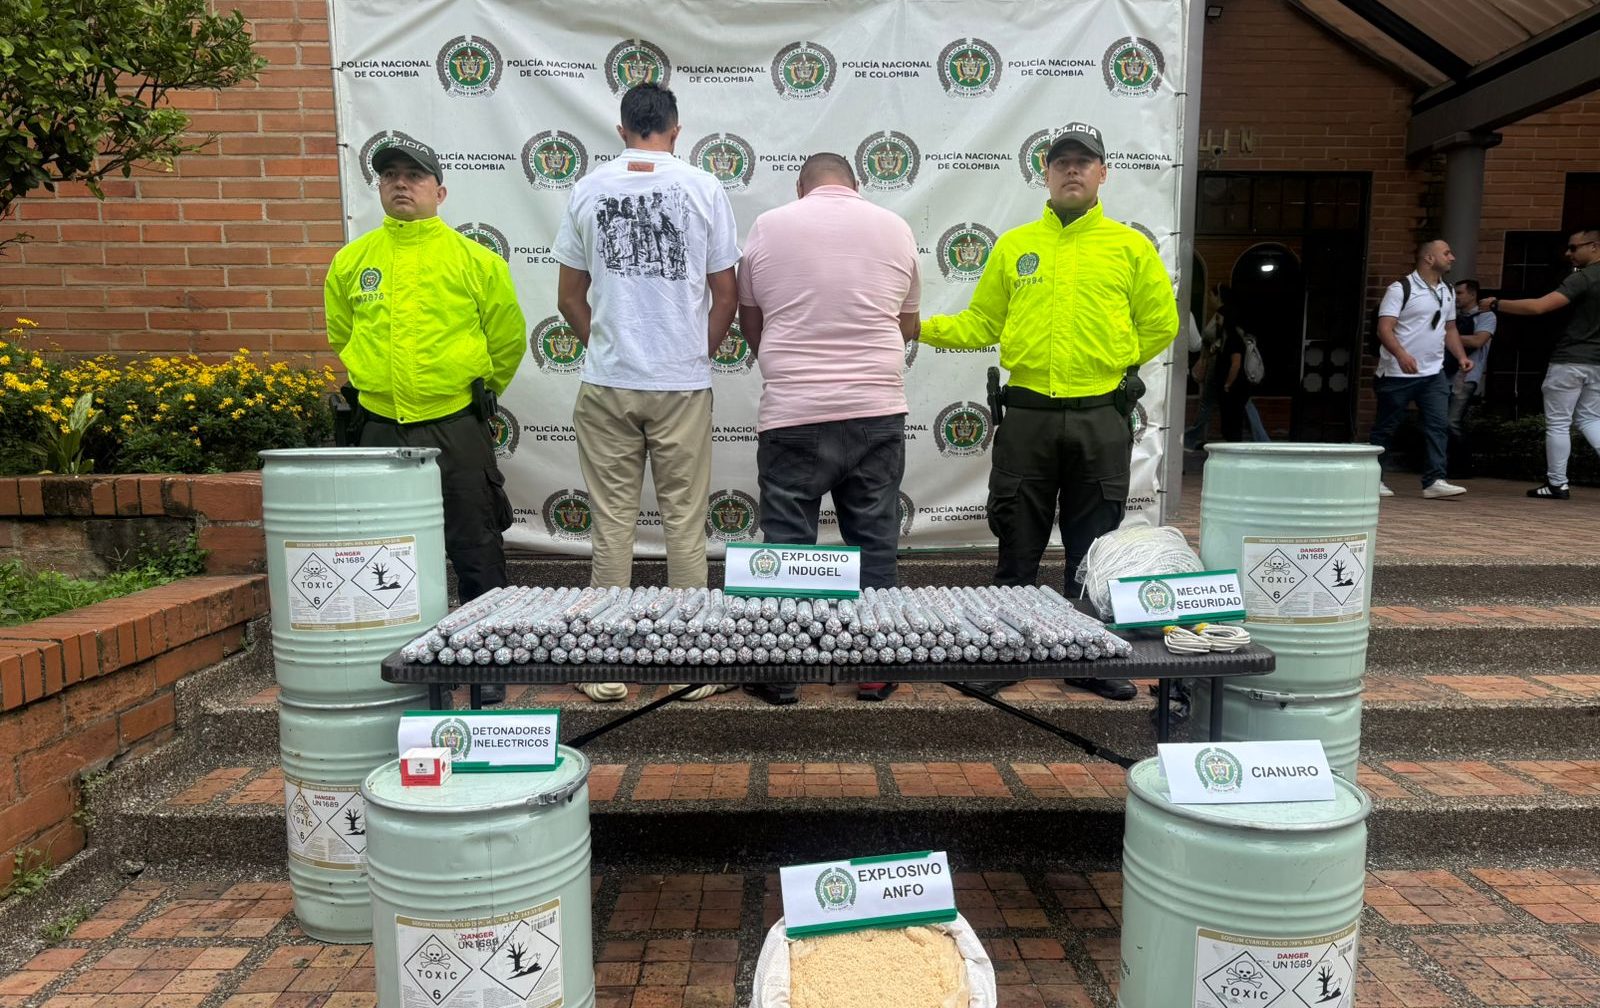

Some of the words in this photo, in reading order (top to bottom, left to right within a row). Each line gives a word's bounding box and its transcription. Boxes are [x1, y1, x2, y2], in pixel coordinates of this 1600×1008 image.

[341, 59, 379, 68] POLICÍA
[506, 58, 544, 68] POLICÍA
[546, 60, 598, 70] NACIONAL
[842, 60, 879, 69] POLICÍA
[1008, 58, 1046, 68] POLICÍA
[533, 69, 585, 79] COLOMBIA
[676, 64, 714, 74] POLICÍA
[1050, 124, 1098, 142] POLICÍA
[434, 152, 464, 161] OLICÍA
[759, 152, 797, 162] POLICÍA
[925, 151, 962, 161] POLICÍA
[1106, 151, 1125, 160] ICÍA
[514, 245, 551, 254] POLICÍA
[918, 505, 954, 514] POLICÍA
[781, 551, 849, 563] EXPLOSIVO
[788, 566, 842, 577] INDUGEL
[1176, 585, 1217, 597] MECHA
[1219, 583, 1236, 593] DE
[1176, 597, 1242, 610] SEGURIDAD
[472, 726, 551, 736] DETONADORES
[474, 738, 549, 748] INELECTRICOS
[1251, 765, 1319, 778] CIANURO
[292, 814, 313, 827] TOXIC
[857, 862, 942, 882] EXPLOSIVO
[882, 883, 924, 899] ANFO
[461, 931, 494, 941] DANGER
[1272, 960, 1288, 969] UN
[1290, 959, 1312, 969] 1689
[416, 969, 458, 980] TOXIC
[432, 989, 441, 1000] 6
[1220, 985, 1268, 1000] TOXIC
